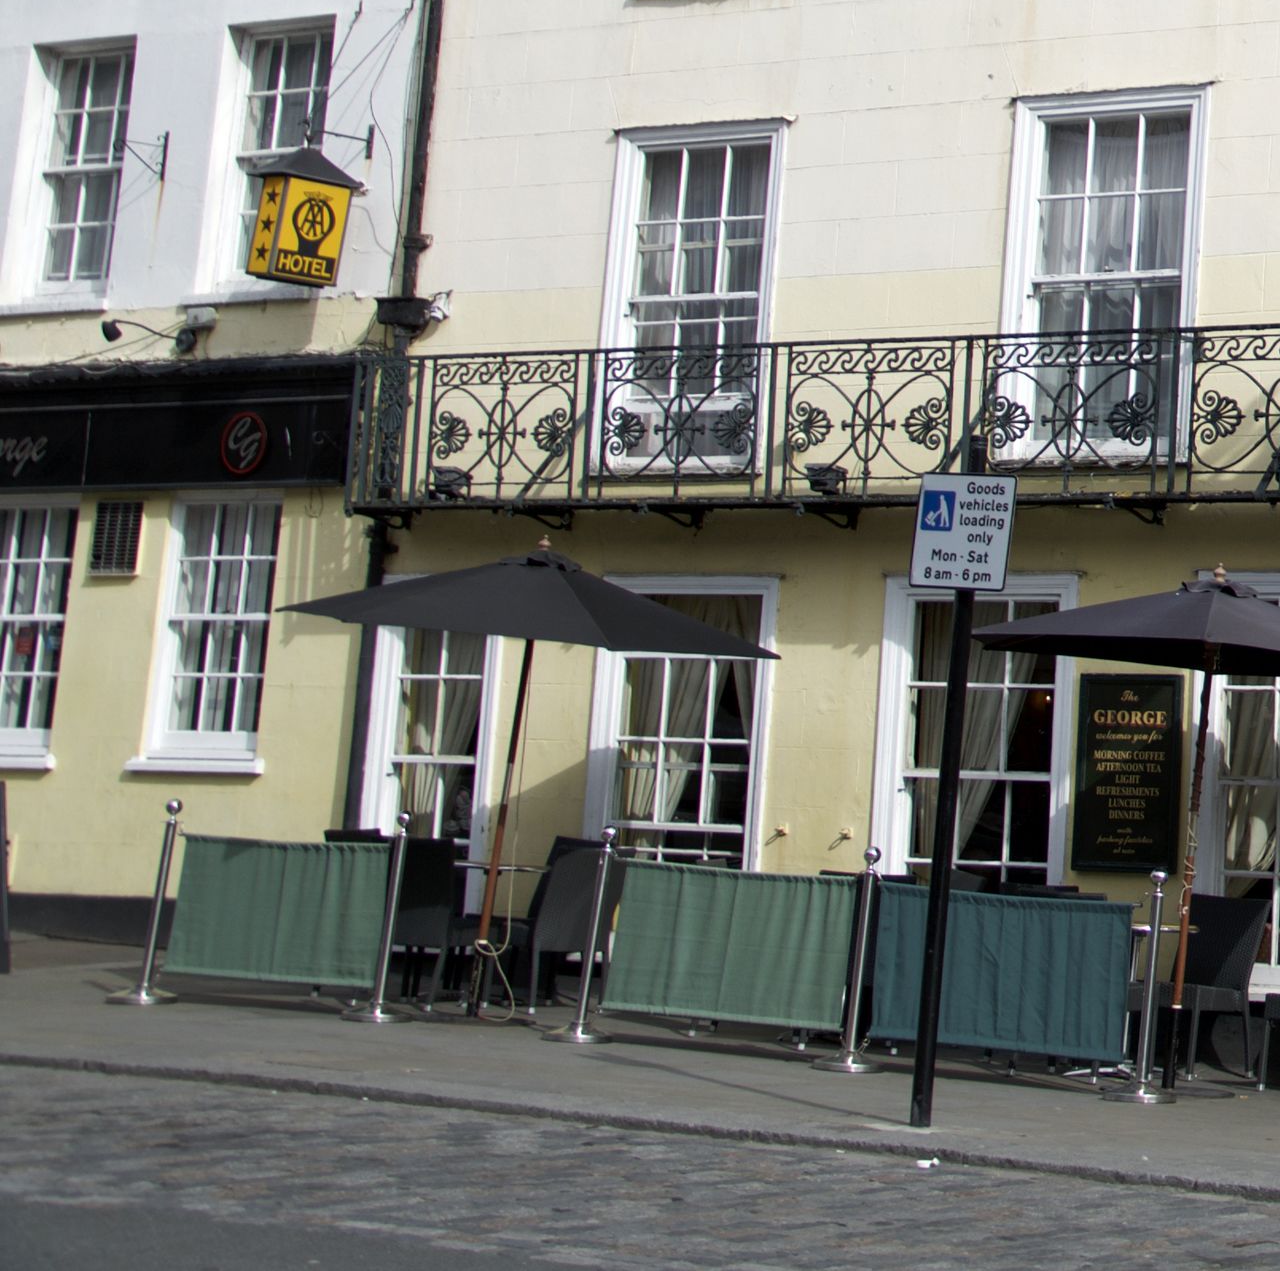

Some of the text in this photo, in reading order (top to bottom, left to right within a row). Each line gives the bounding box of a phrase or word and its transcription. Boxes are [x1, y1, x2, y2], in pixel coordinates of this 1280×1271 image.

[278, 252, 331, 278] HOTEL
[967, 481, 1006, 496] Goods
[960, 498, 1009, 512] vehicles
[960, 514, 1005, 530] loading
[967, 531, 993, 546] only
[931, 548, 957, 562] Mon
[967, 550, 989, 564] Sat
[924, 566, 932, 579] 8
[934, 569, 952, 580] am
[962, 568, 970, 581] 6
[972, 572, 991, 584] pm
[1120, 689, 1139, 702] The
[1093, 709, 1167, 726] GEORGE
[1093, 749, 1166, 761] MORNING COFFEE
[1096, 761, 1162, 773] AFTERNOON TEA
[1115, 774, 1141, 784] LIGHT
[1096, 786, 1160, 797] REFRESHMENTS
[1108, 798, 1146, 808] LUNCHES
[1108, 810, 1145, 820] DINNERS
